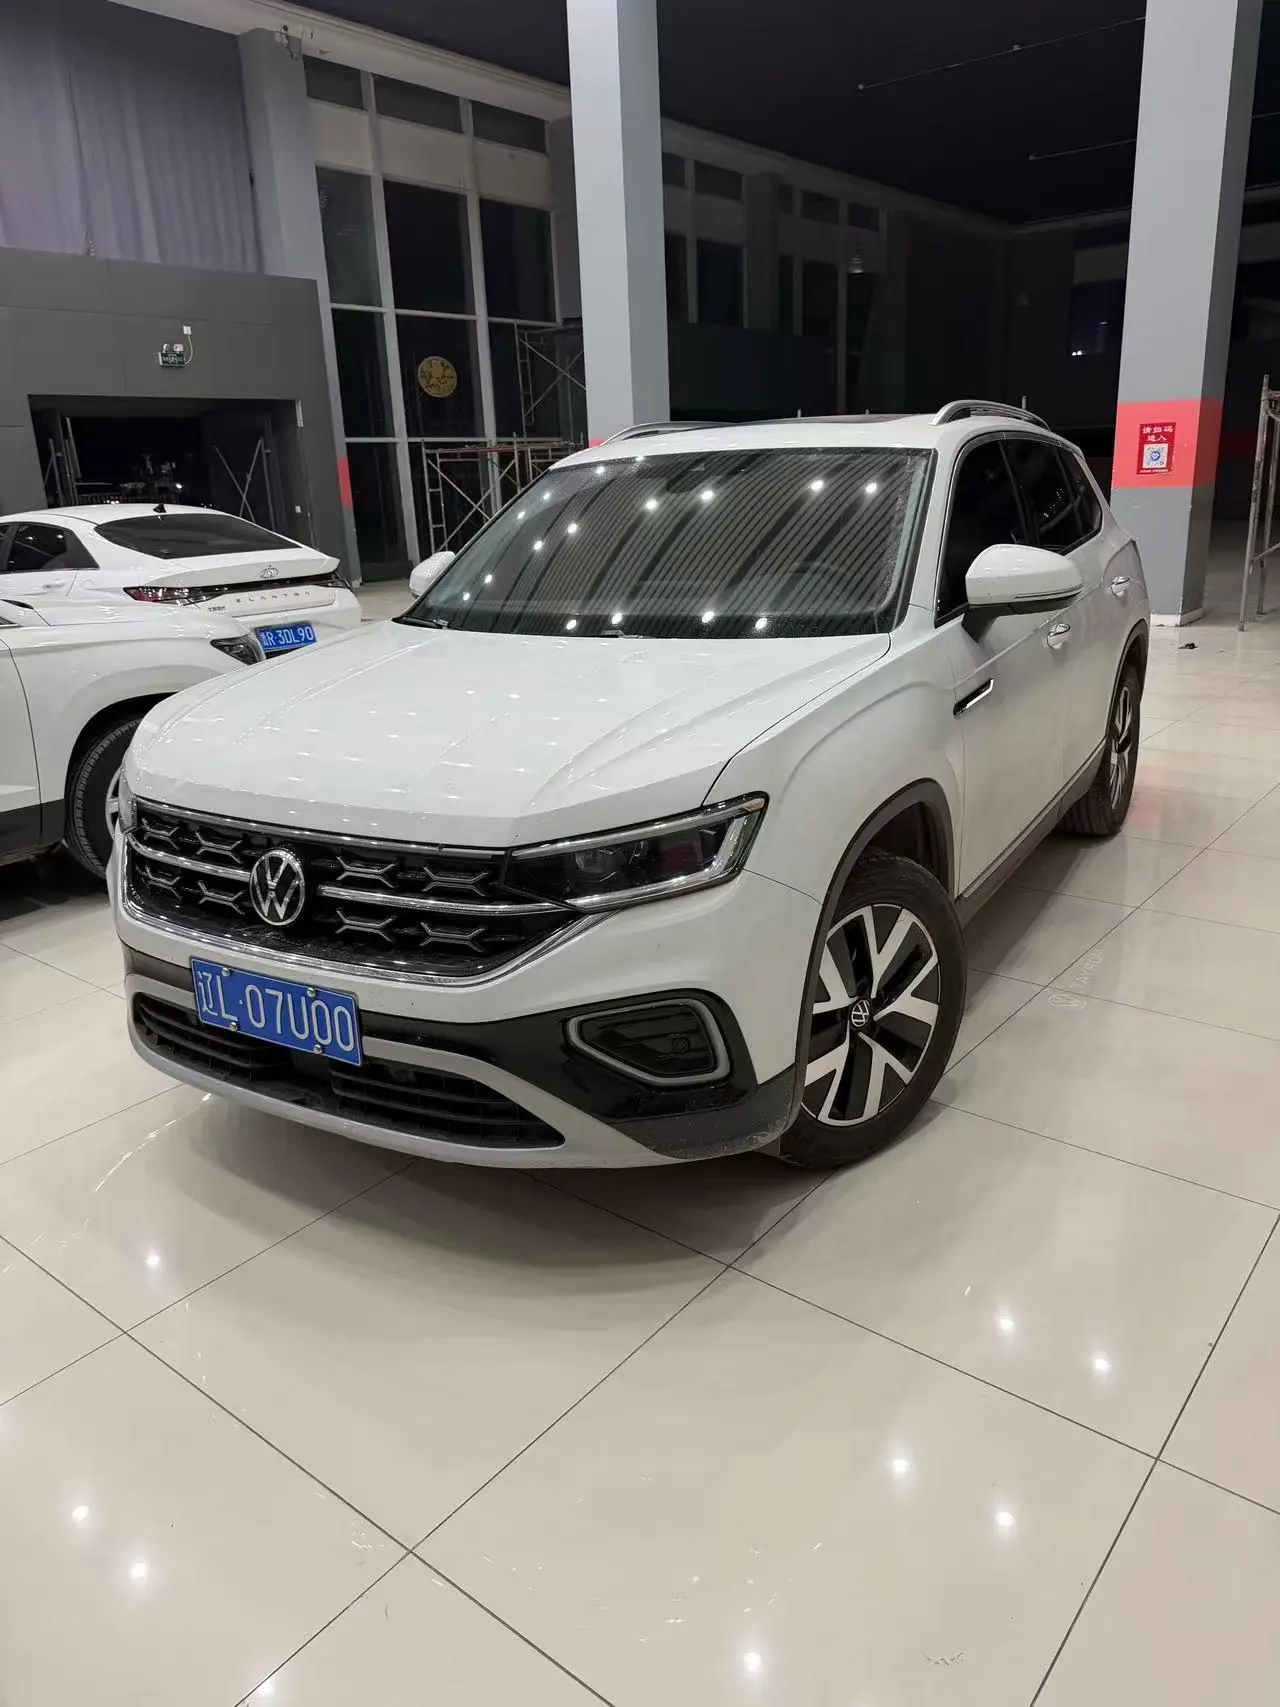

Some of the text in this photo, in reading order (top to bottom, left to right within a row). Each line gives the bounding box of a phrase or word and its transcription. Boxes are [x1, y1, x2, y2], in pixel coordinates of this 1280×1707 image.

[1142, 425, 1174, 434] 请扫码
[1146, 434, 1168, 442] 进入
[236, 590, 311, 604] ELANTRA
